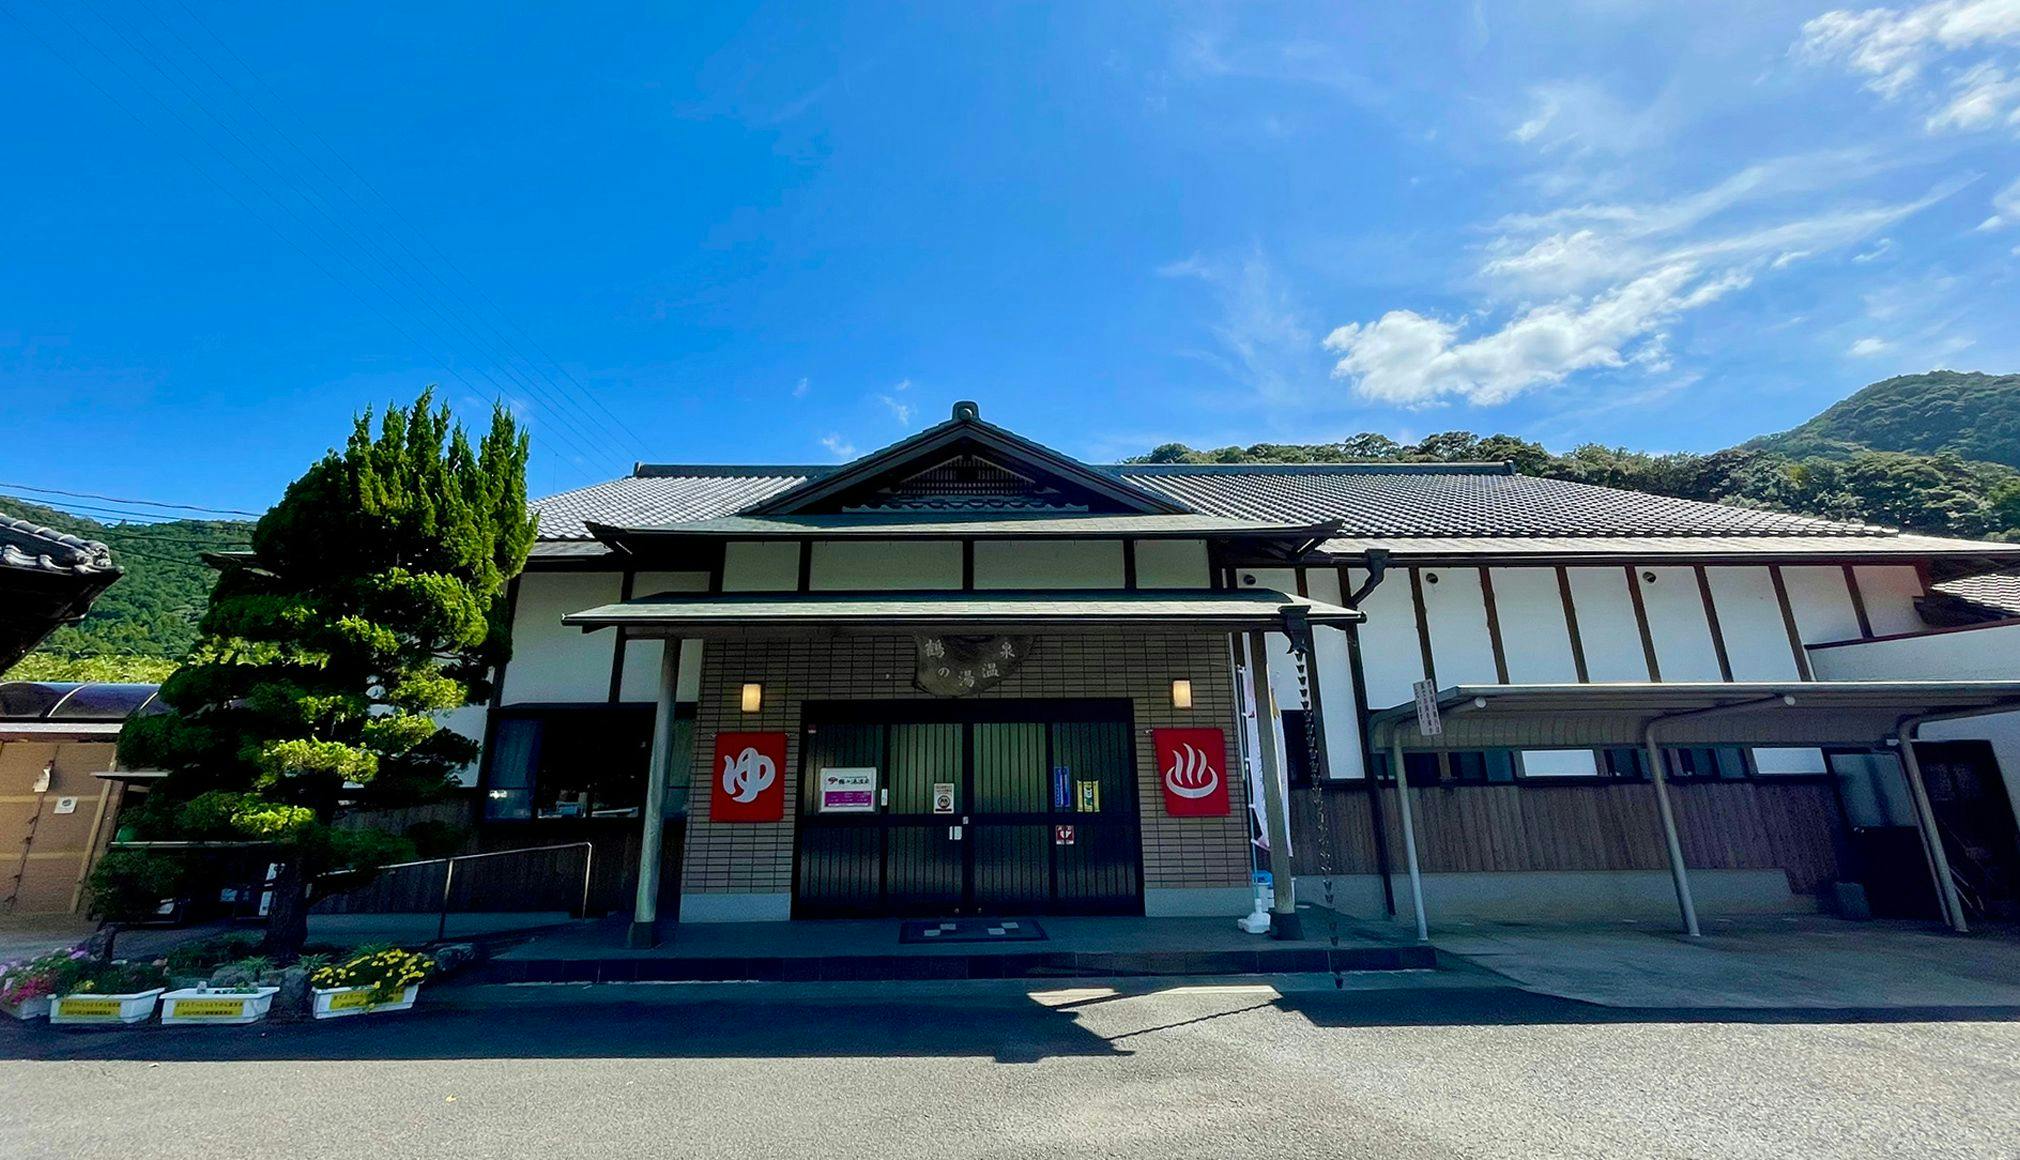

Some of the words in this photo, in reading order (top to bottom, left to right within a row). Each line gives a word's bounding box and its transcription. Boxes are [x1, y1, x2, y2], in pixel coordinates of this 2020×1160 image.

[925, 638, 1015, 688] 鶴の湯温泉
[723, 747, 776, 804] ゆ
